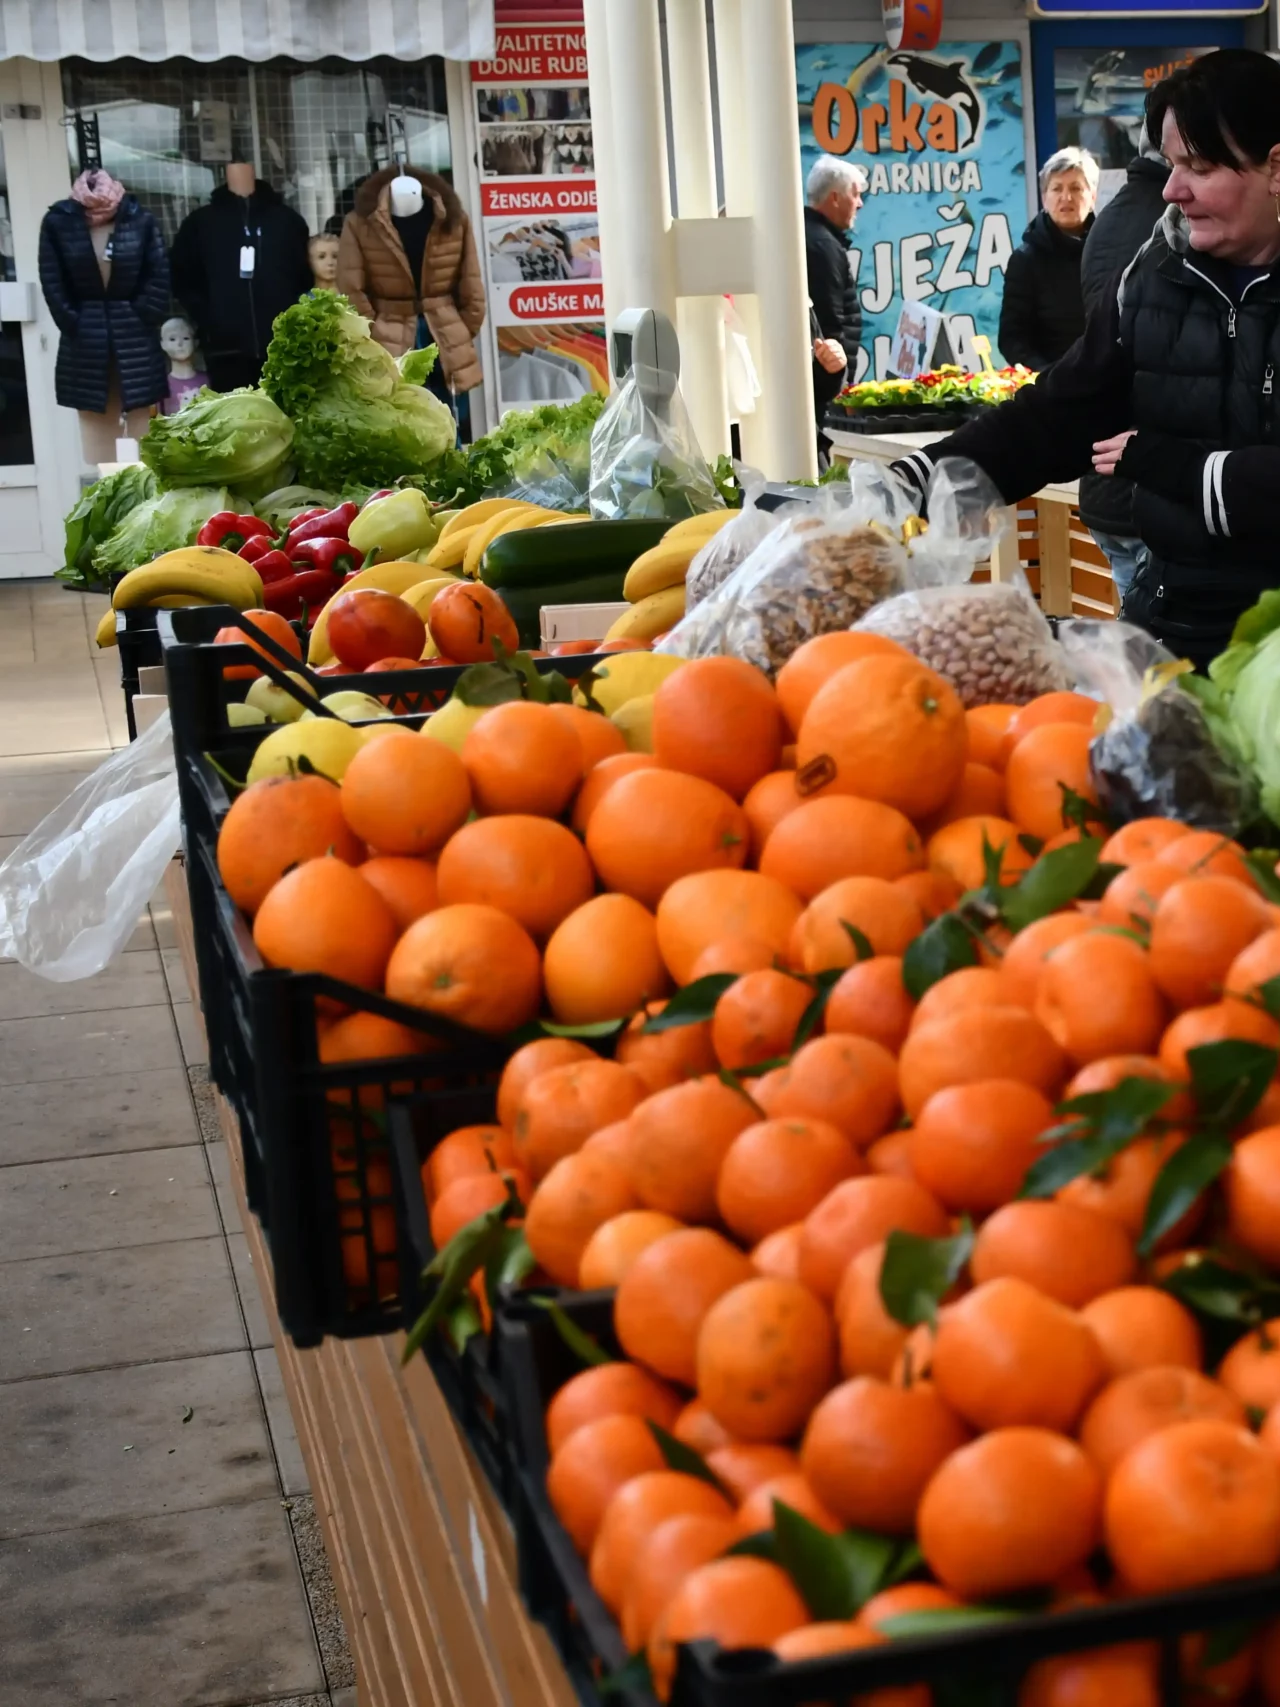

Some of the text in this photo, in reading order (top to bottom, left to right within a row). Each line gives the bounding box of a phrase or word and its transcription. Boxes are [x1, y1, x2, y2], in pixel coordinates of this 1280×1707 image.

[478, 57, 541, 75] DONJE
[812, 79, 958, 156] Orka
[489, 191, 553, 209] ŽENSKA
[516, 293, 579, 312] MUŠKE
